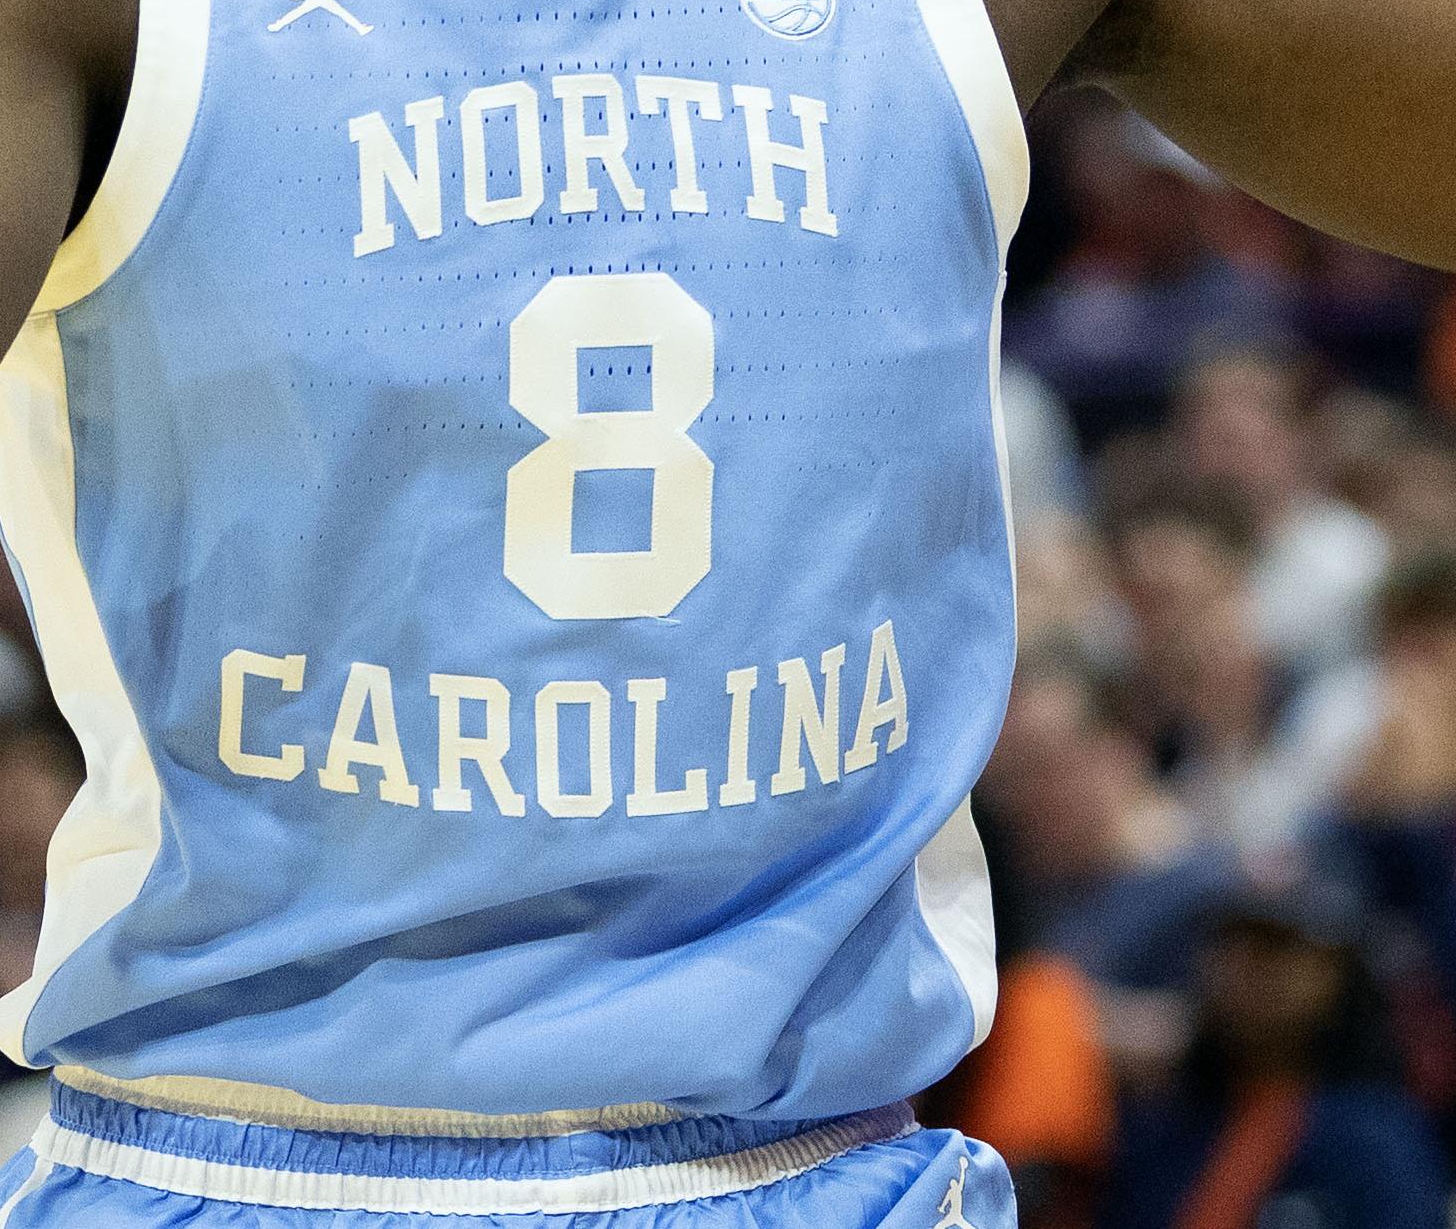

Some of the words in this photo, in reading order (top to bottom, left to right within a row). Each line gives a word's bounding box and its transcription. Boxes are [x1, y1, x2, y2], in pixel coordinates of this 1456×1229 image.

[349, 73, 841, 257] NORTH
[503, 271, 716, 620] 8
[217, 619, 911, 819] CAROLINA
